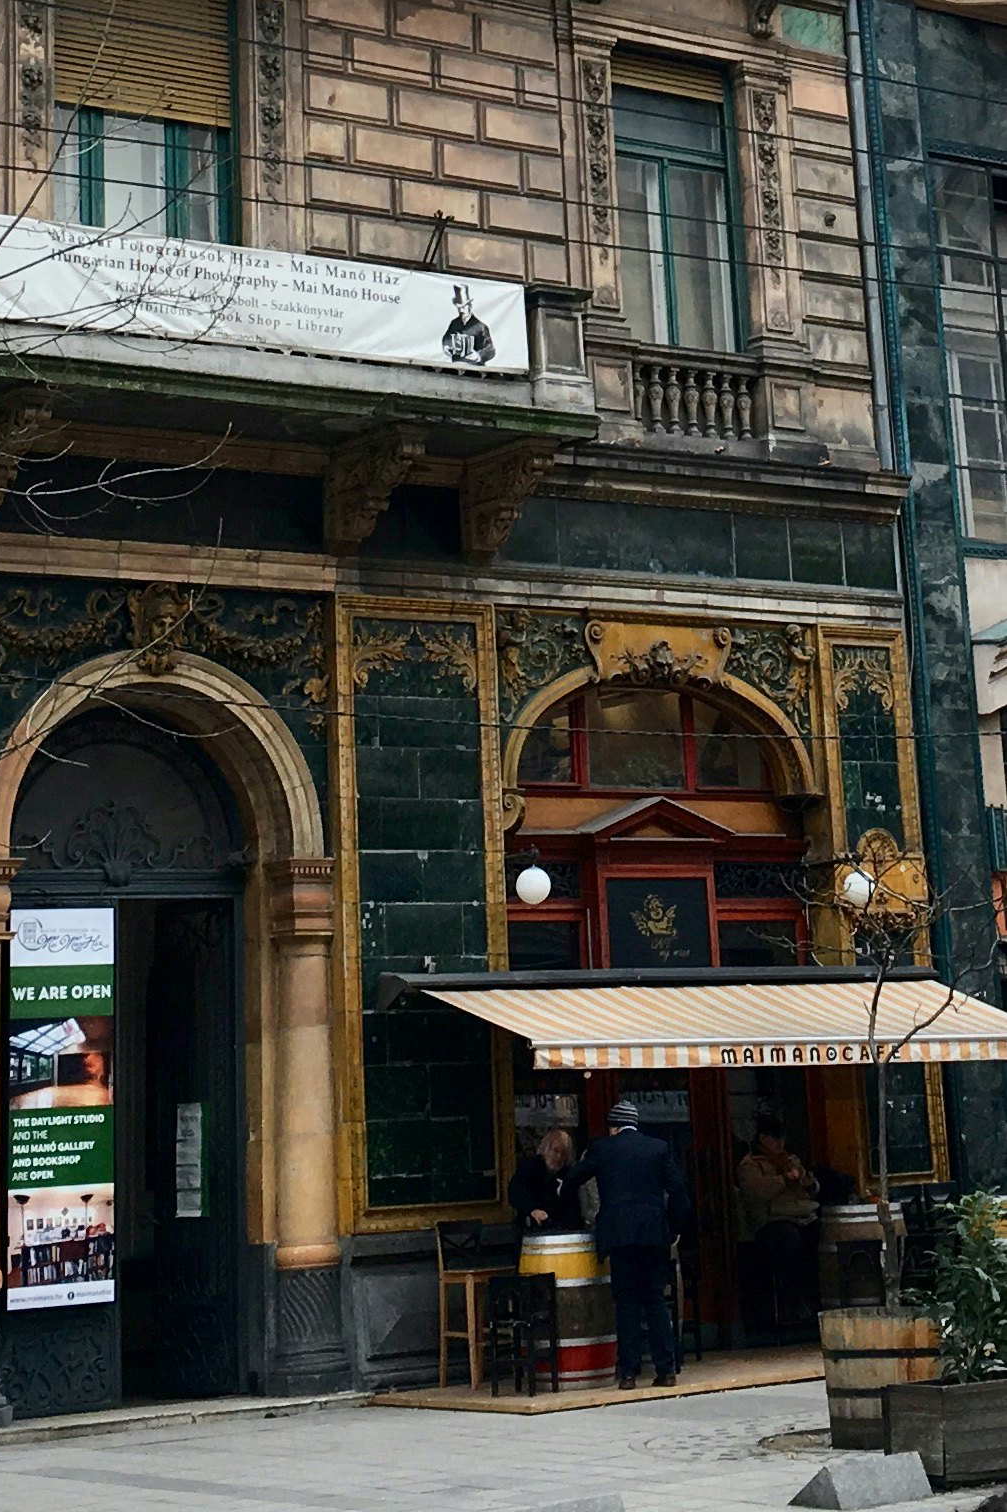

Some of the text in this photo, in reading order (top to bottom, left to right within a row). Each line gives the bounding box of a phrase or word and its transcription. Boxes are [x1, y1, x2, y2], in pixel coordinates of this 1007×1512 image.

[233, 252, 270, 269] Háza
[290, 260, 318, 275] Mai
[326, 264, 366, 281] Manó
[373, 270, 400, 286] Ház
[51, 248, 125, 270] Hungarian
[130, 258, 173, 276] House
[176, 265, 191, 278] of
[194, 266, 278, 293] Photography
[293, 279, 318, 294] Mai
[322, 283, 358, 299] Manó
[361, 288, 401, 304] House
[248, 313, 281, 330] Shop
[297, 319, 344, 338] Library
[12, 984, 111, 1001] WE ARE OPEN
[13, 1114, 105, 1127] THE DAYLIGHT STUDIO
[12, 1130, 48, 1141] AND THE
[13, 1144, 29, 1154] MAI
[58, 1141, 95, 1152] GALLERY
[12, 1155, 81, 1168] AND BOOKSHOP
[12, 1170, 55, 1181] ARE OPEN.
